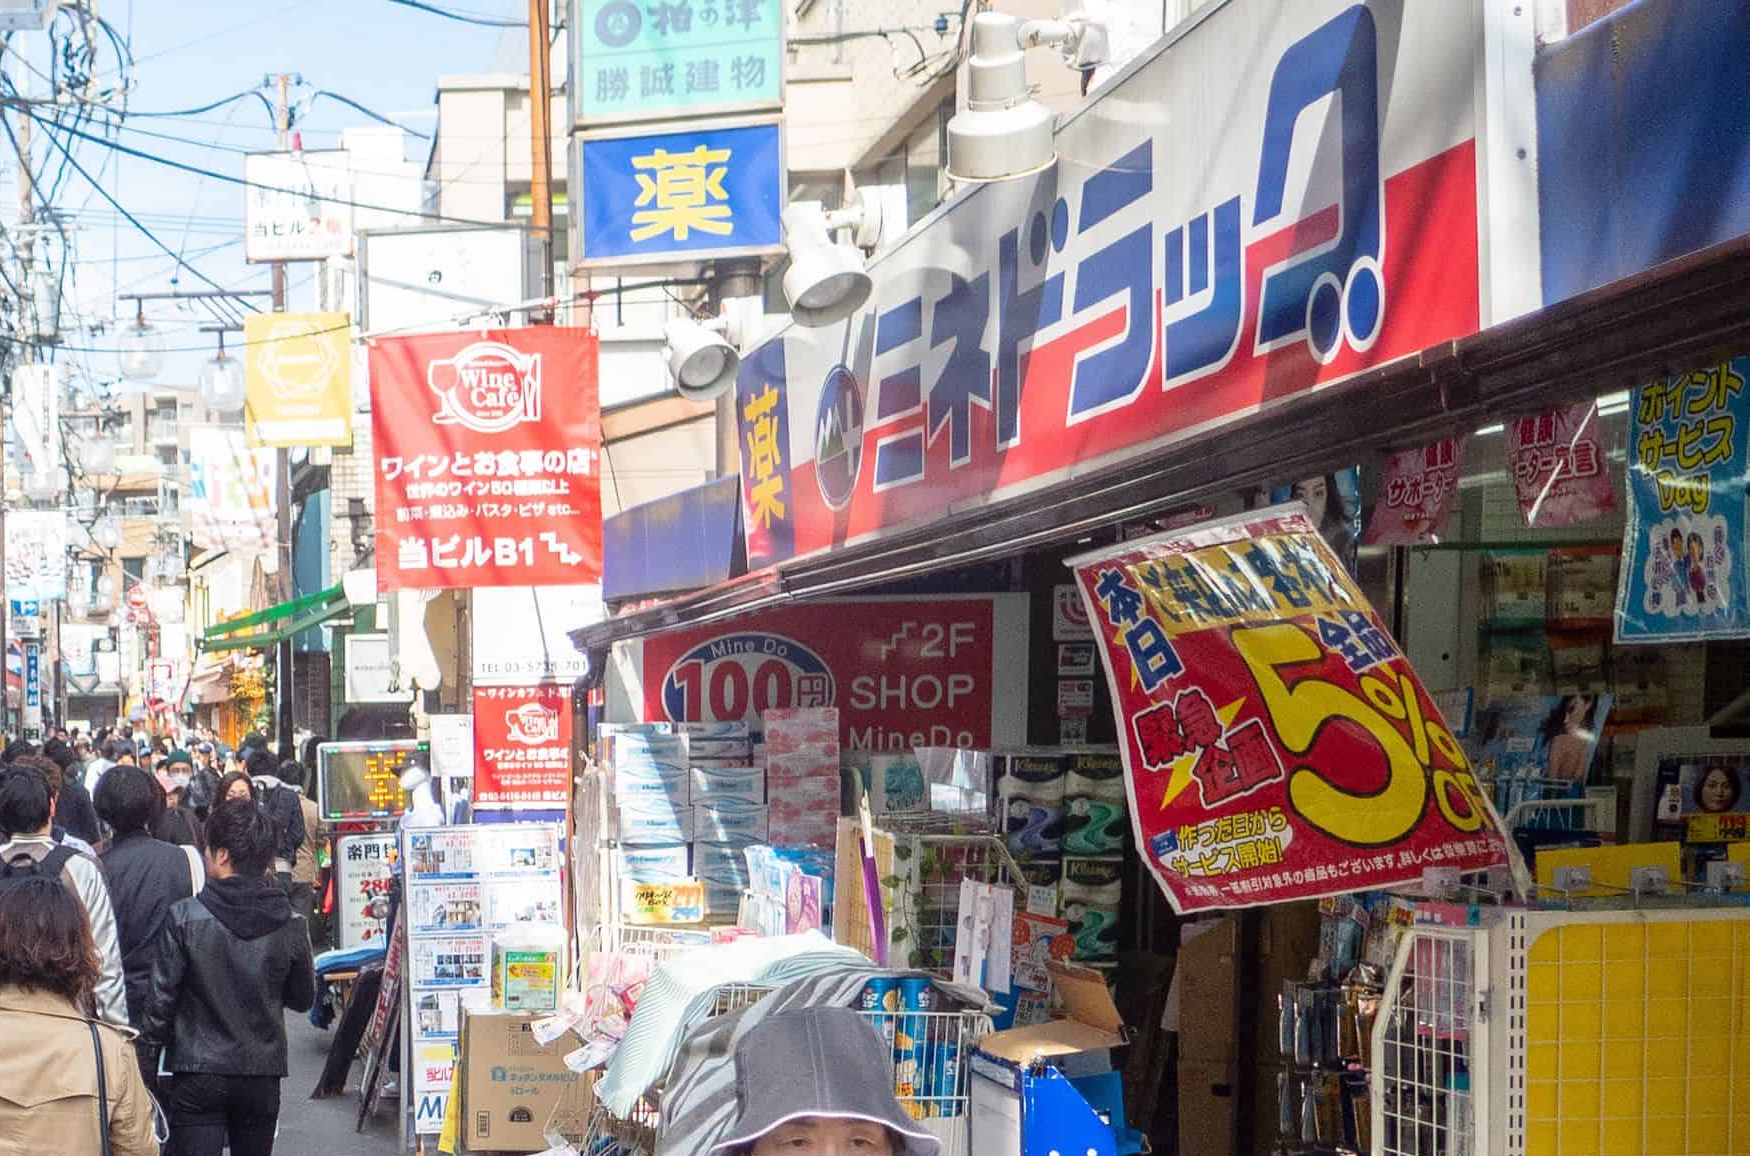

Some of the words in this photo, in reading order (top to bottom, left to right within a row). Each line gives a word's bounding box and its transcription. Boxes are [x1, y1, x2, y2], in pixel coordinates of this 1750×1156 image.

[629, 144, 734, 242] 薬
[873, 5, 1387, 494] ミネドラッグ
[459, 368, 515, 390] Wine
[1638, 363, 1744, 425] ポイント
[381, 446, 591, 481] ワインとお食事の店
[743, 385, 786, 531] 薬
[1637, 415, 1734, 472] サービス
[1657, 472, 1710, 514] Day
[398, 534, 535, 570] 当ビルB1
[709, 638, 755, 659] Mine
[763, 637, 787, 657] Do
[921, 623, 976, 658] 2F
[1096, 568, 1185, 695] 本日
[480, 662, 500, 674] TEL
[676, 658, 794, 721] 100
[851, 673, 975, 711] SHOP
[849, 723, 974, 751] MineDo
[1192, 719, 1285, 809] 企画
[1178, 805, 1289, 852] 作った日から
[1170, 836, 1286, 878] サービス開始!
